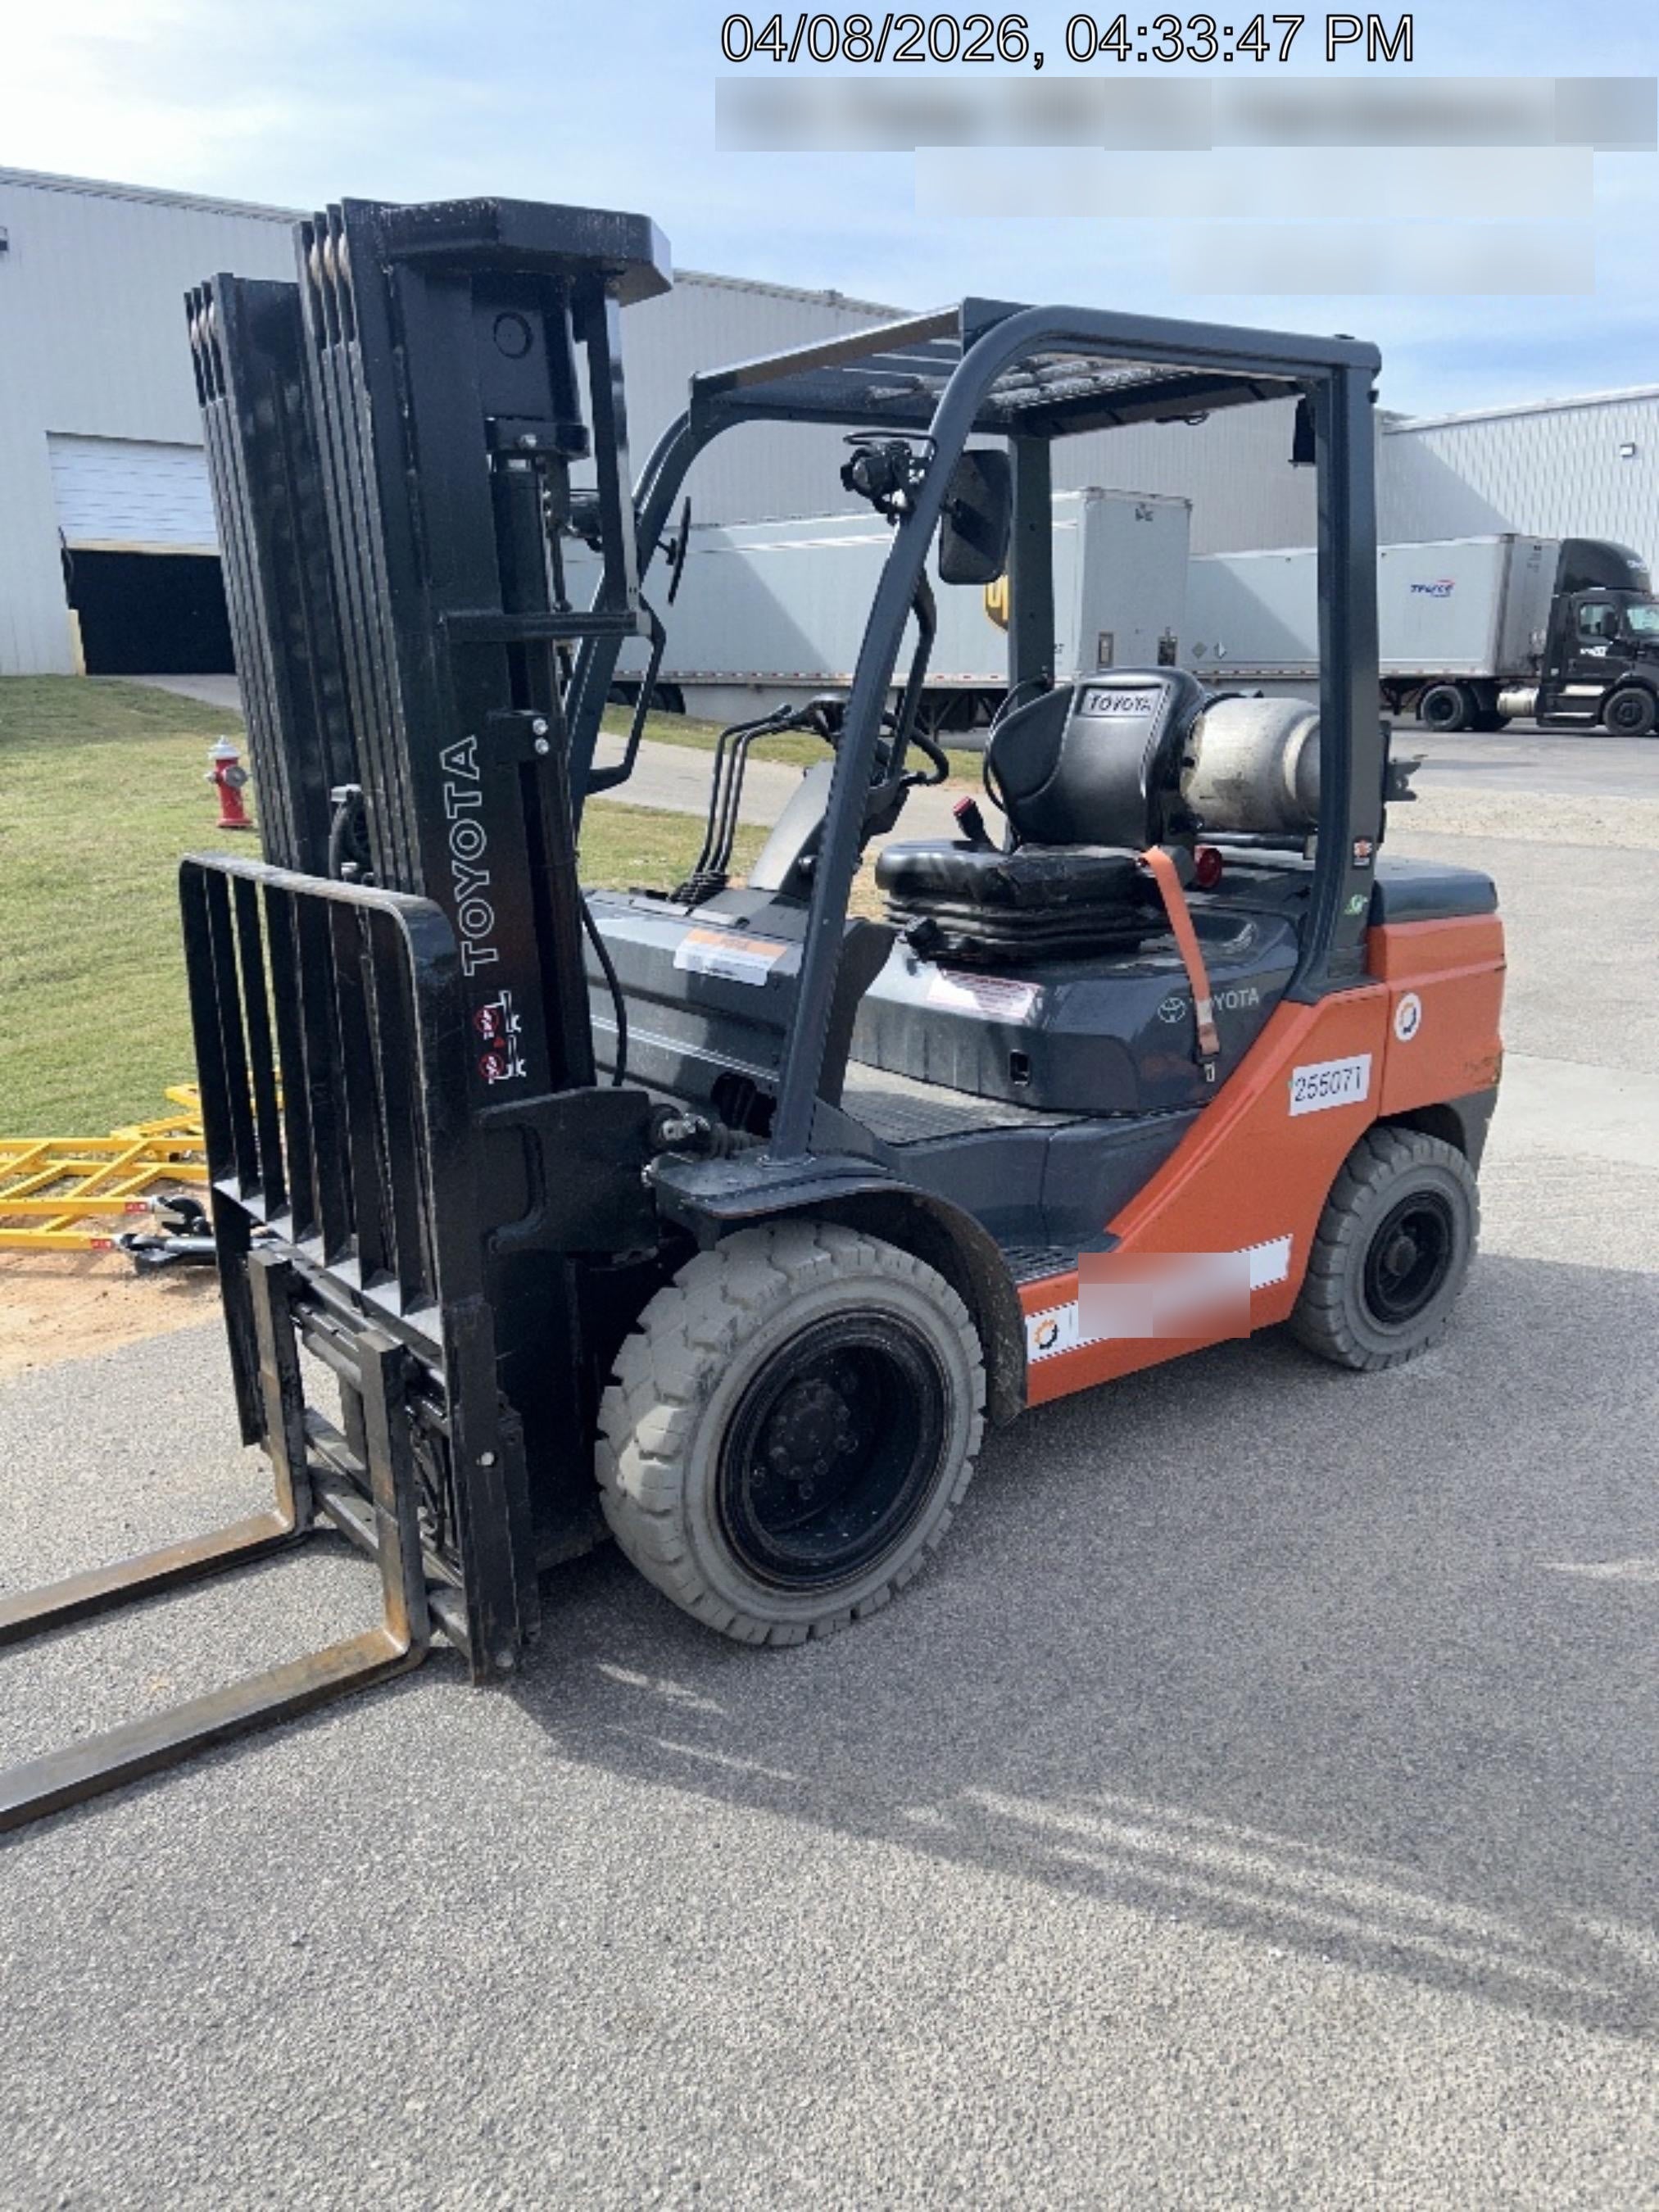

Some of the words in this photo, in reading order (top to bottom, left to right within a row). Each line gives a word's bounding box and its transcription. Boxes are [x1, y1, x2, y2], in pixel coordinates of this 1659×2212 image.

[1088, 694, 1151, 711] TOYOTA
[440, 736, 498, 977] TOYOTA
[1190, 986, 1260, 1012] YOTA
[1294, 1066, 1361, 1102] 255071
